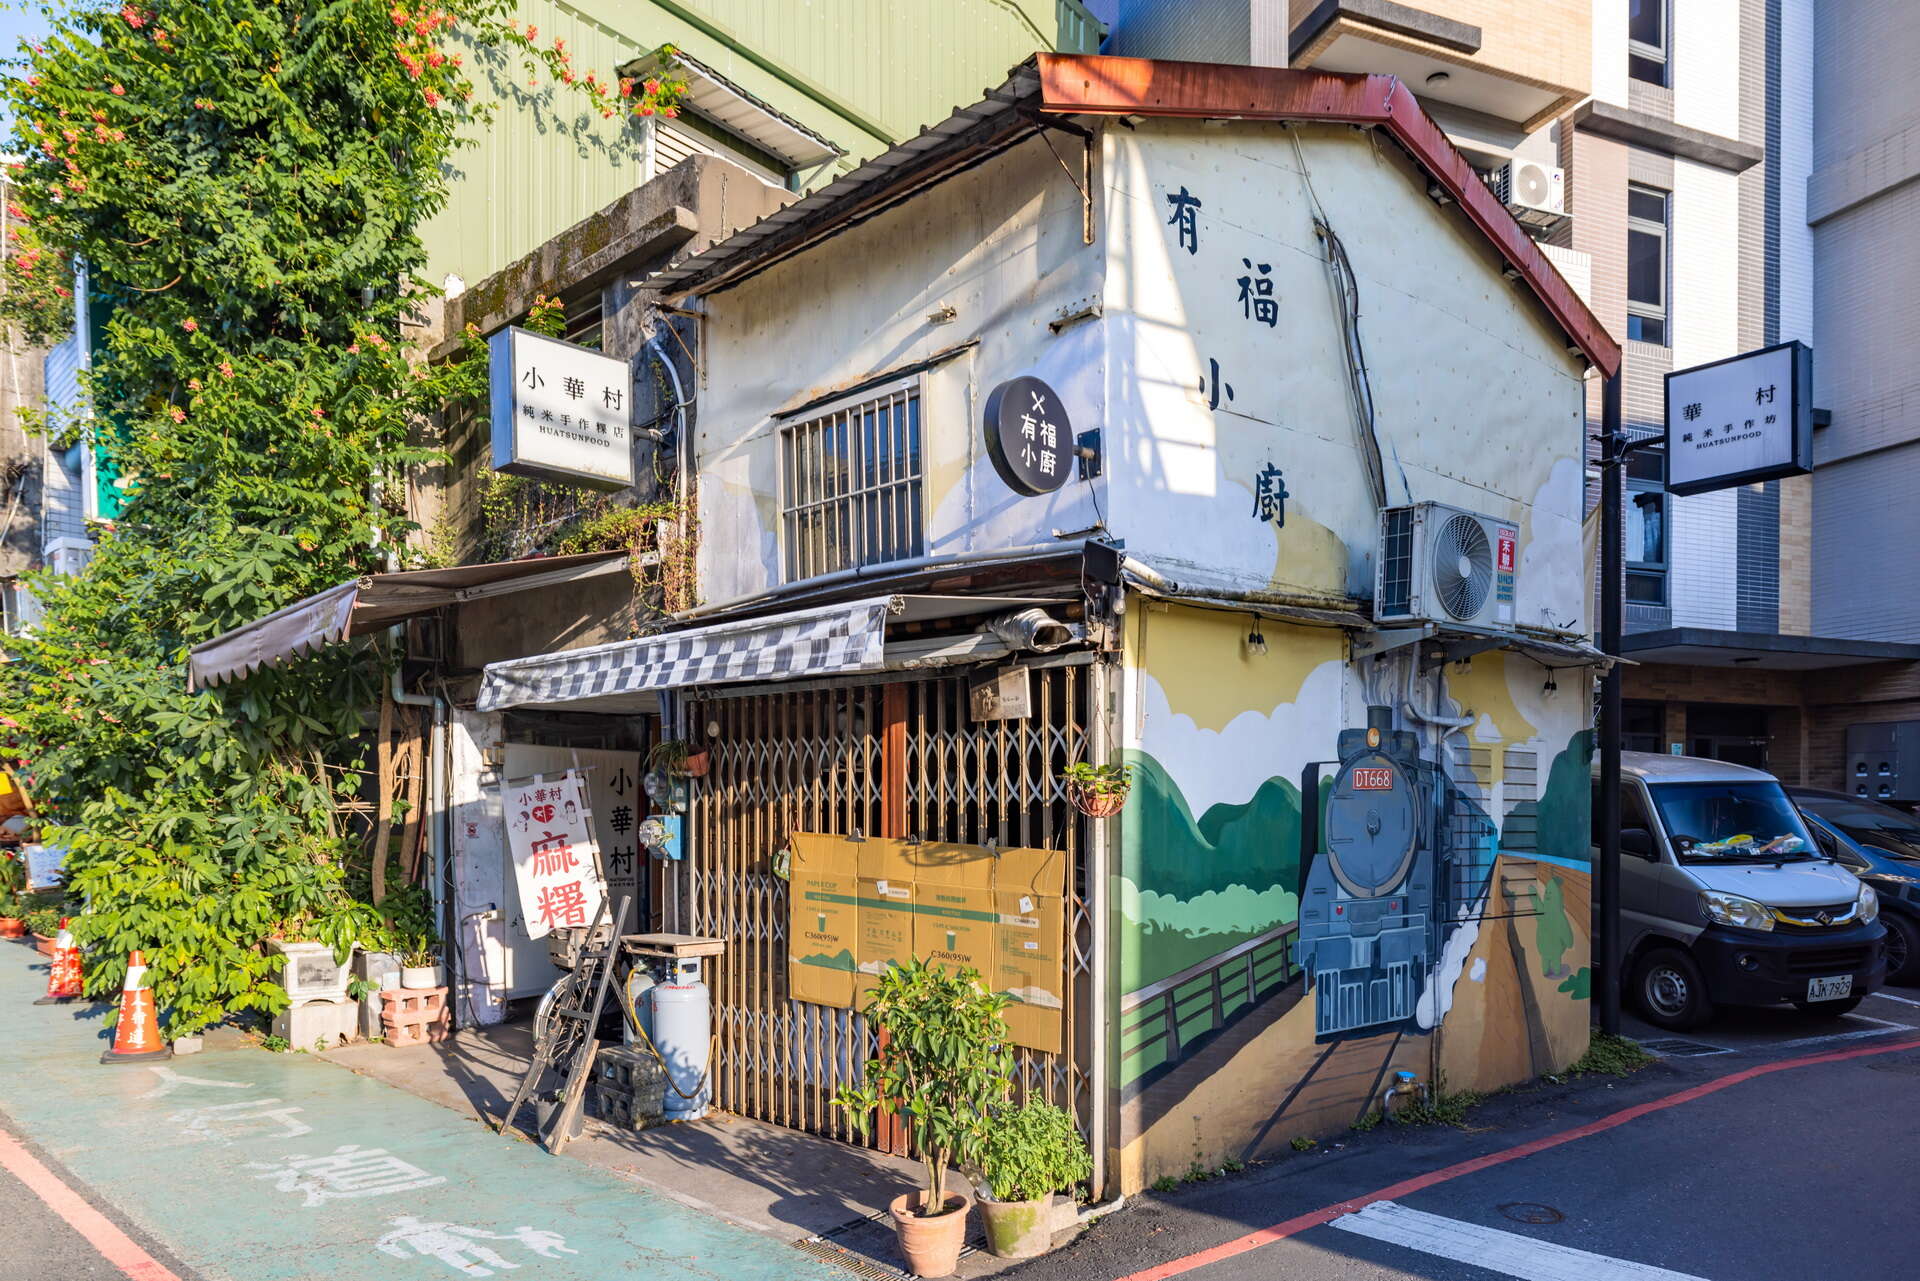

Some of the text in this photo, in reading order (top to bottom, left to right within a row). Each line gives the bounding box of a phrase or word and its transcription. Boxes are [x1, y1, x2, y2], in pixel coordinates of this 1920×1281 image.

[522, 367, 623, 411] 小華村
[1682, 384, 1776, 422] 華村
[523, 404, 624, 439] 純米手作粿店
[539, 425, 610, 448] HUATSUNFOOD
[1021, 413, 1056, 449] 有福
[1682, 414, 1776, 443] 純米手作坊
[1696, 430, 1762, 450] HUATSUNFOOD
[1021, 443, 1056, 477] 小廚
[1356, 770, 1390, 787] DT668
[519, 786, 563, 806] 小華村
[610, 768, 635, 875] 小華村
[531, 831, 588, 929] 麻糬
[931, 950, 972, 963] C360(95)W
